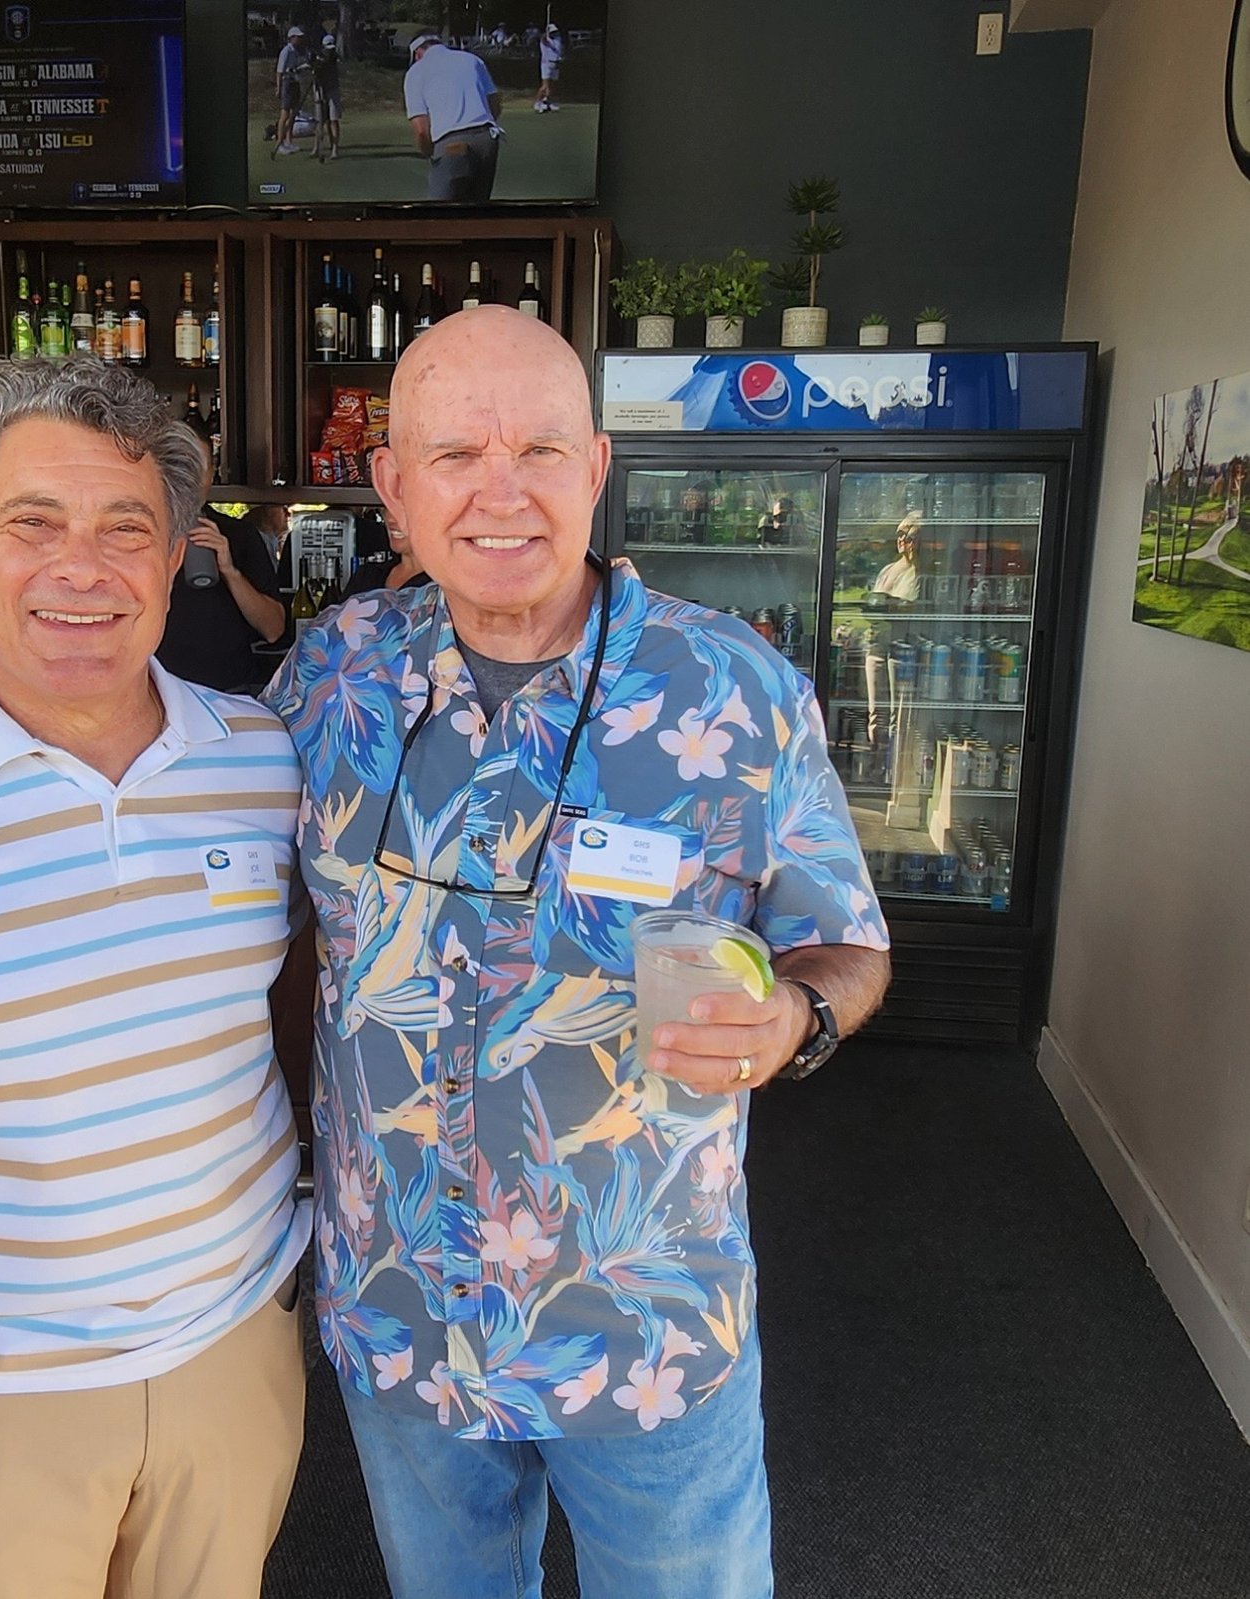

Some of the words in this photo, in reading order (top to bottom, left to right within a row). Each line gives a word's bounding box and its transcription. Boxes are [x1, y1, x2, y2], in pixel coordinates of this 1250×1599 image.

[38, 64, 94, 80] ALABAMA
[30, 99, 94, 114] TENNESSEE
[39, 133, 61, 149] LSU
[62, 135, 93, 147] LSU
[0, 164, 44, 174] SATURDAY
[802, 366, 941, 418] pepsi
[629, 854, 649, 864] BOB
